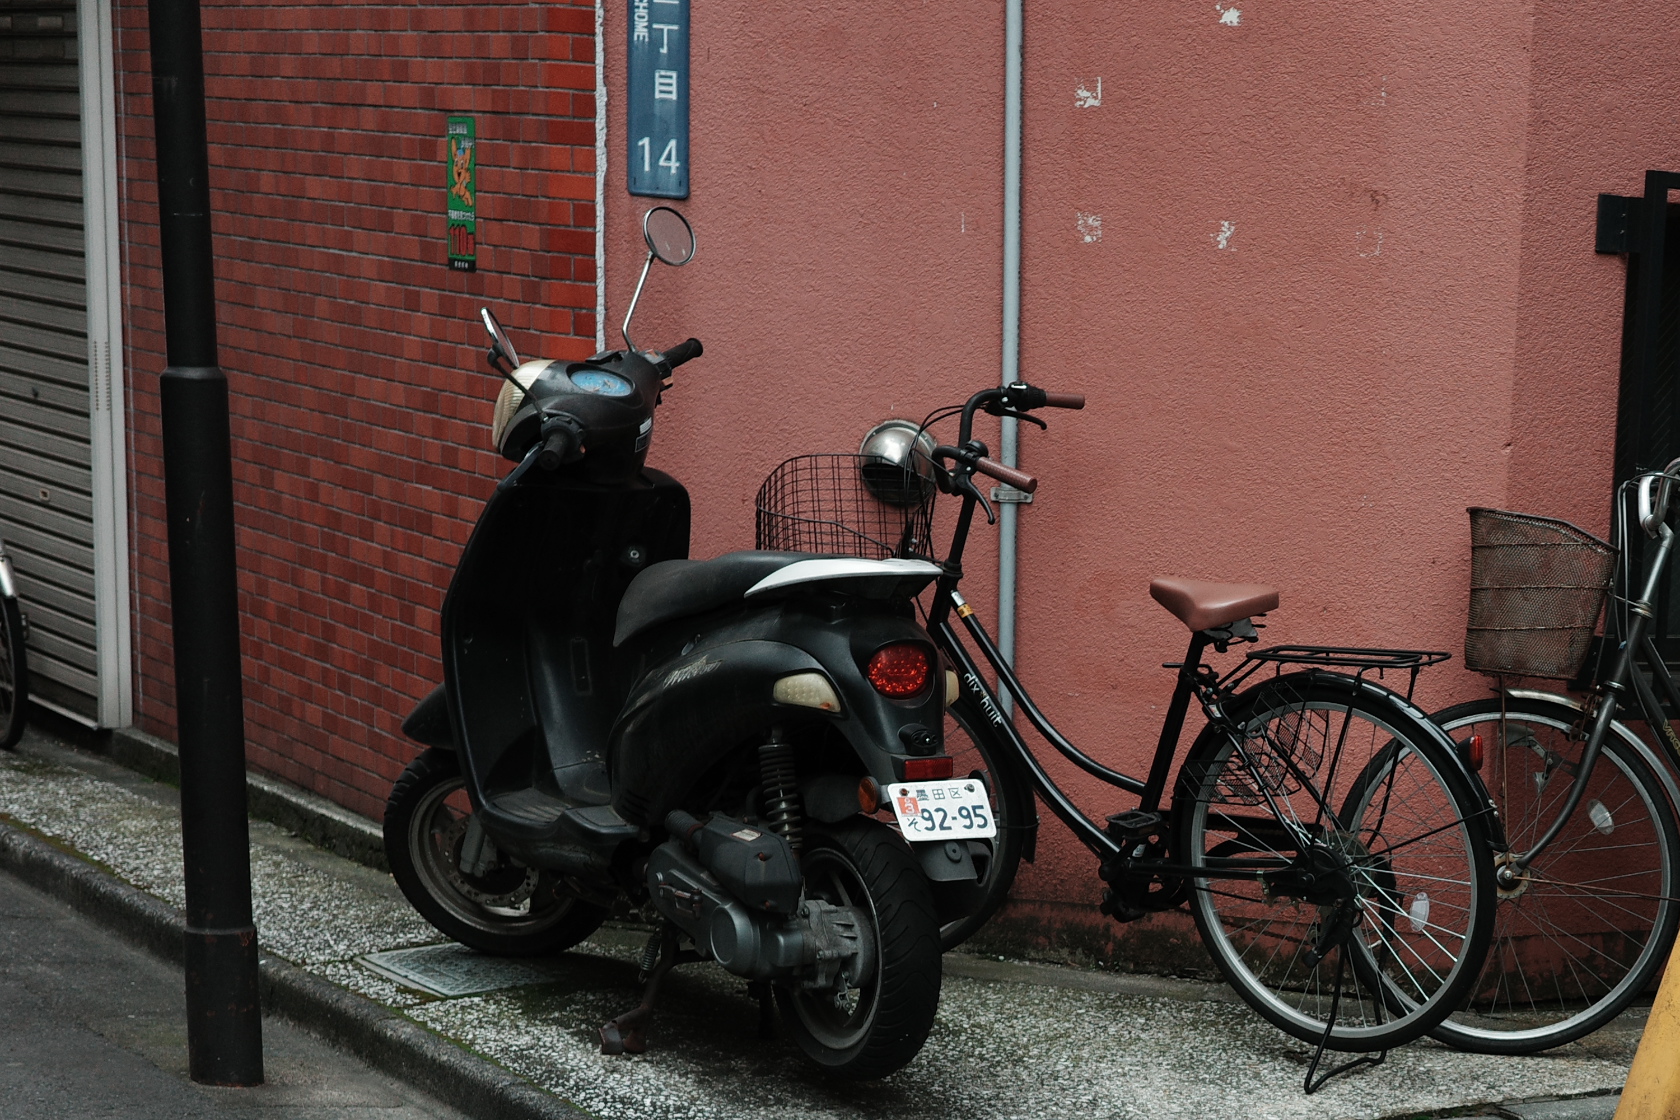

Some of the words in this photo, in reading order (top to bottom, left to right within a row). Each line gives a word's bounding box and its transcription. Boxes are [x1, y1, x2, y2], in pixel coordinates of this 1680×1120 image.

[652, 0, 680, 100] 丁目
[637, 136, 680, 175] 14
[963, 672, 980, 694] dix
[979, 696, 1002, 727] huit
[916, 787, 963, 801] 墨田区
[921, 805, 988, 832] 92-95
